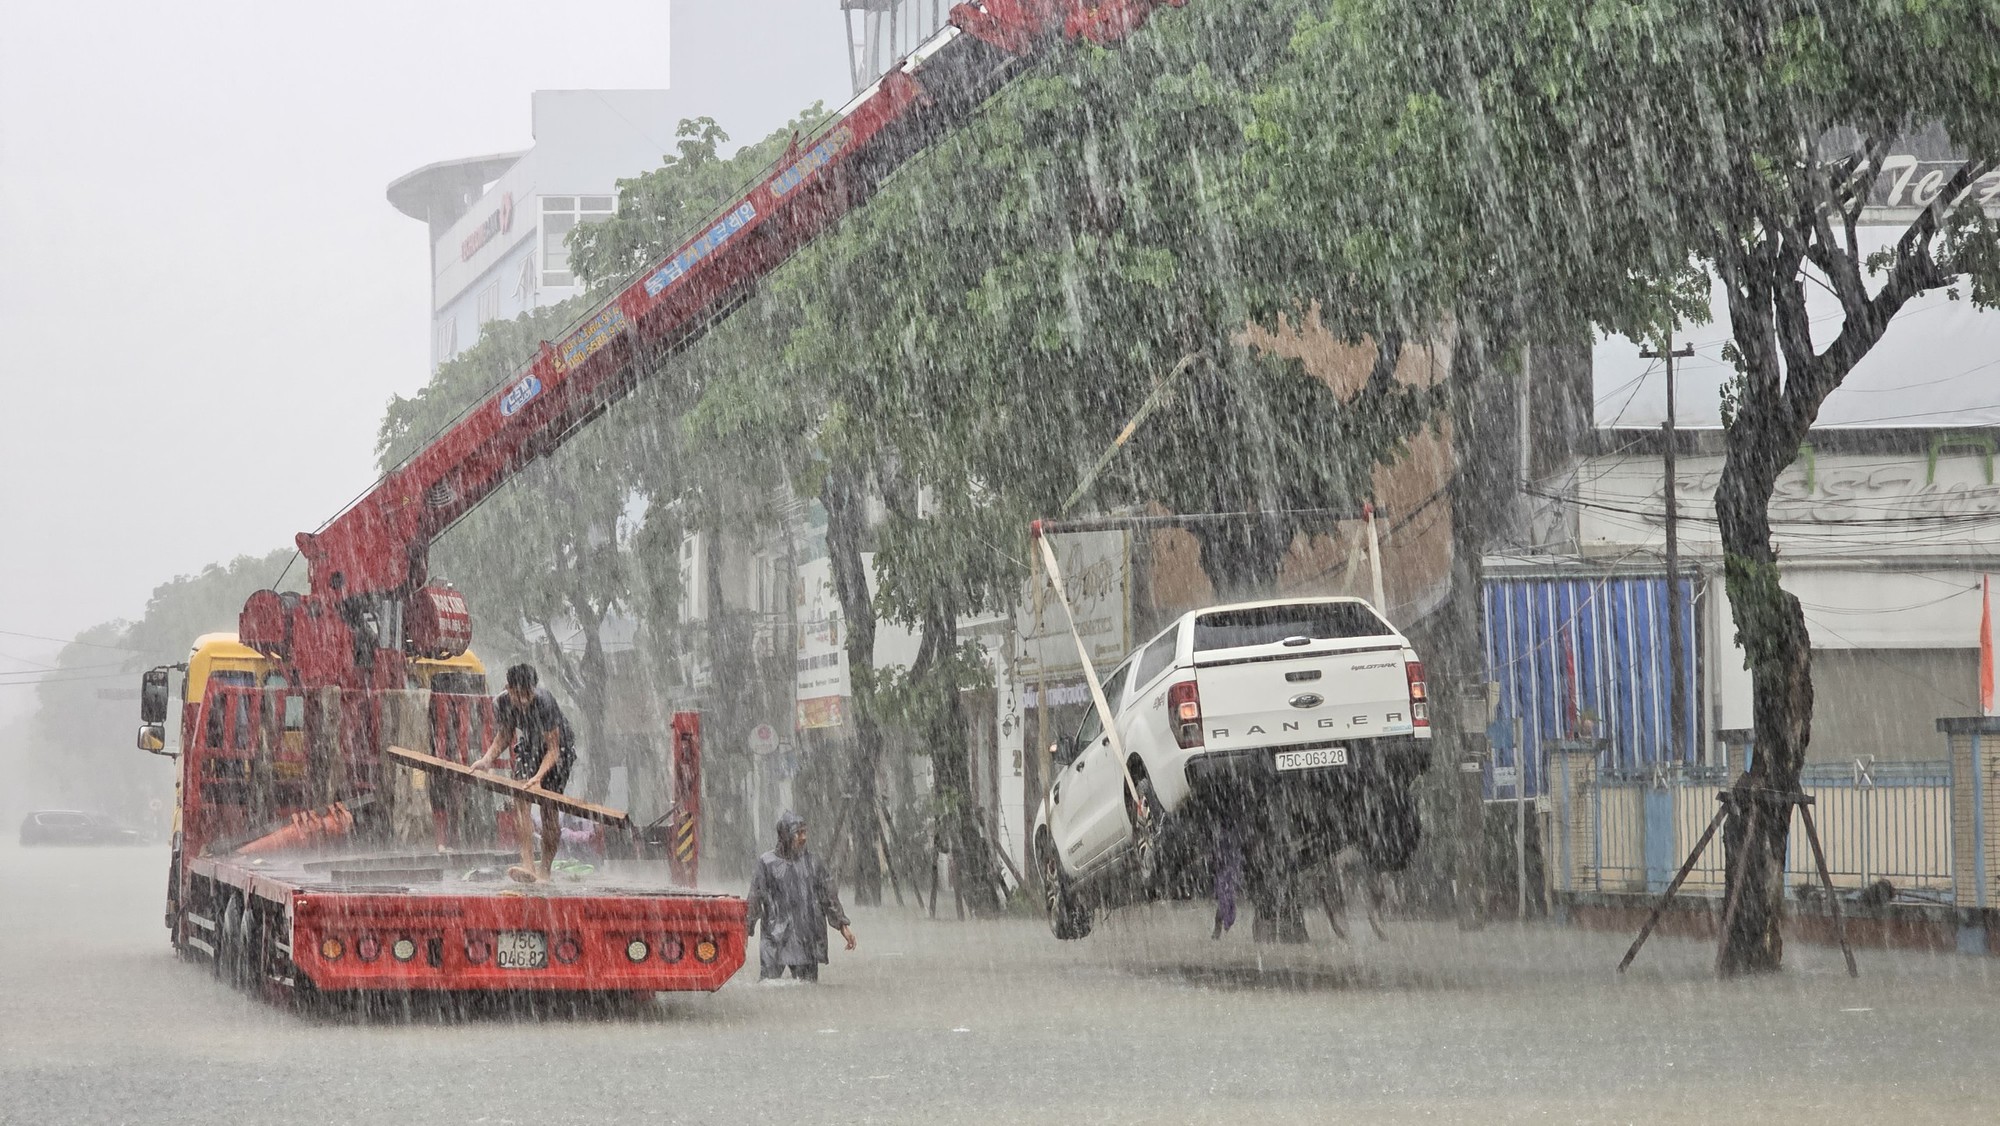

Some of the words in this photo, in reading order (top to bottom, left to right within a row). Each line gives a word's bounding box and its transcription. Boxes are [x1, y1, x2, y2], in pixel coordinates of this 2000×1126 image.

[1350, 662, 1397, 671] WILDTRAK
[1212, 712, 1403, 739] RANGER
[1279, 750, 1345, 769] 75C-063.28
[511, 933, 537, 950] 75C
[498, 950, 546, 967] 046.82
